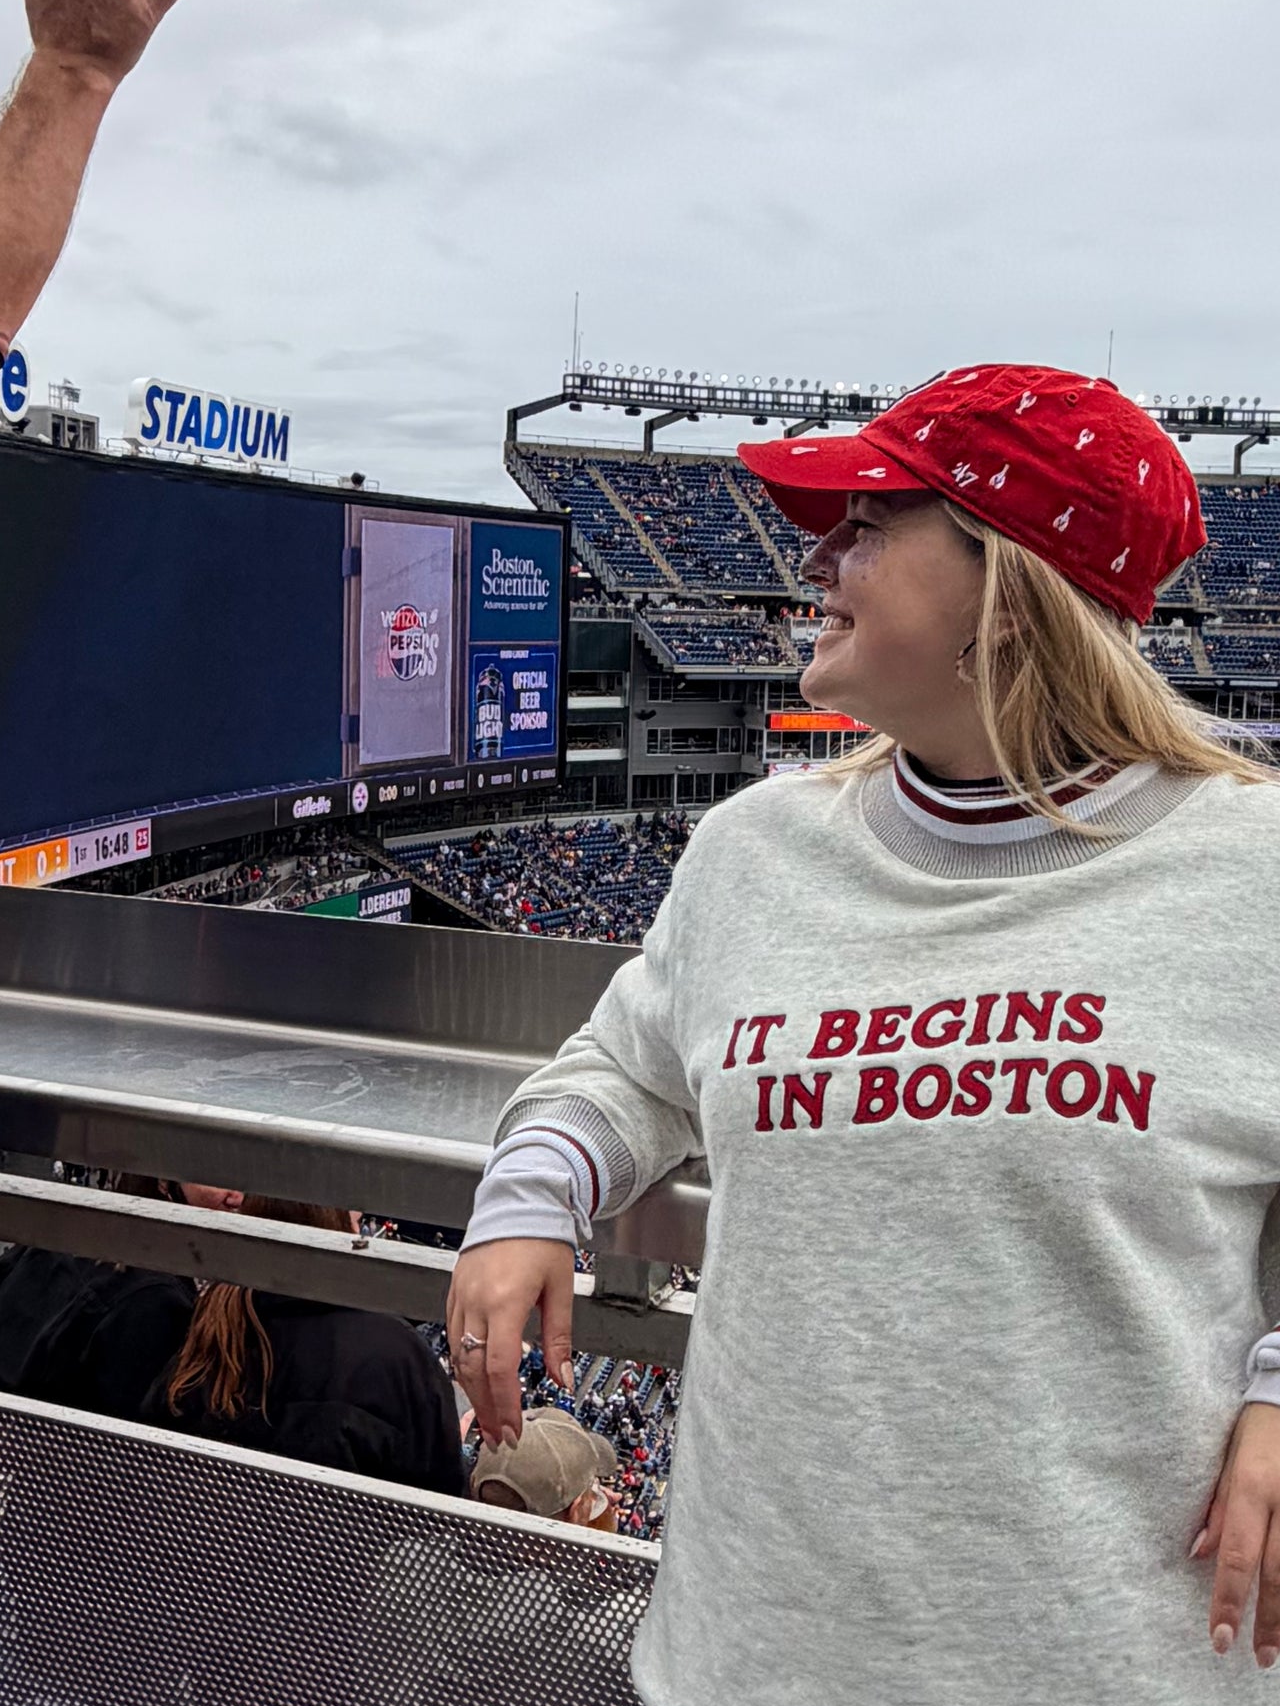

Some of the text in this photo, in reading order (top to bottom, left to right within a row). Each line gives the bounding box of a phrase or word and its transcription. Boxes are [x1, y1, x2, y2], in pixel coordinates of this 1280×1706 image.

[141, 384, 290, 462] STADIUM
[492, 548, 534, 576] Boston
[482, 566, 550, 598] Scientific
[513, 671, 548, 690] OFFICIAL
[520, 692, 540, 710] BEER
[510, 712, 548, 731] SPONSOR
[293, 796, 332, 819] Gillette
[379, 785, 398, 802] 0:00
[37, 850, 48, 879] 0
[95, 831, 129, 861] 16:48
[138, 830, 149, 848] 25
[722, 990, 1107, 1070] IT BEGINS
[755, 1058, 1156, 1132] IN BOSTON
